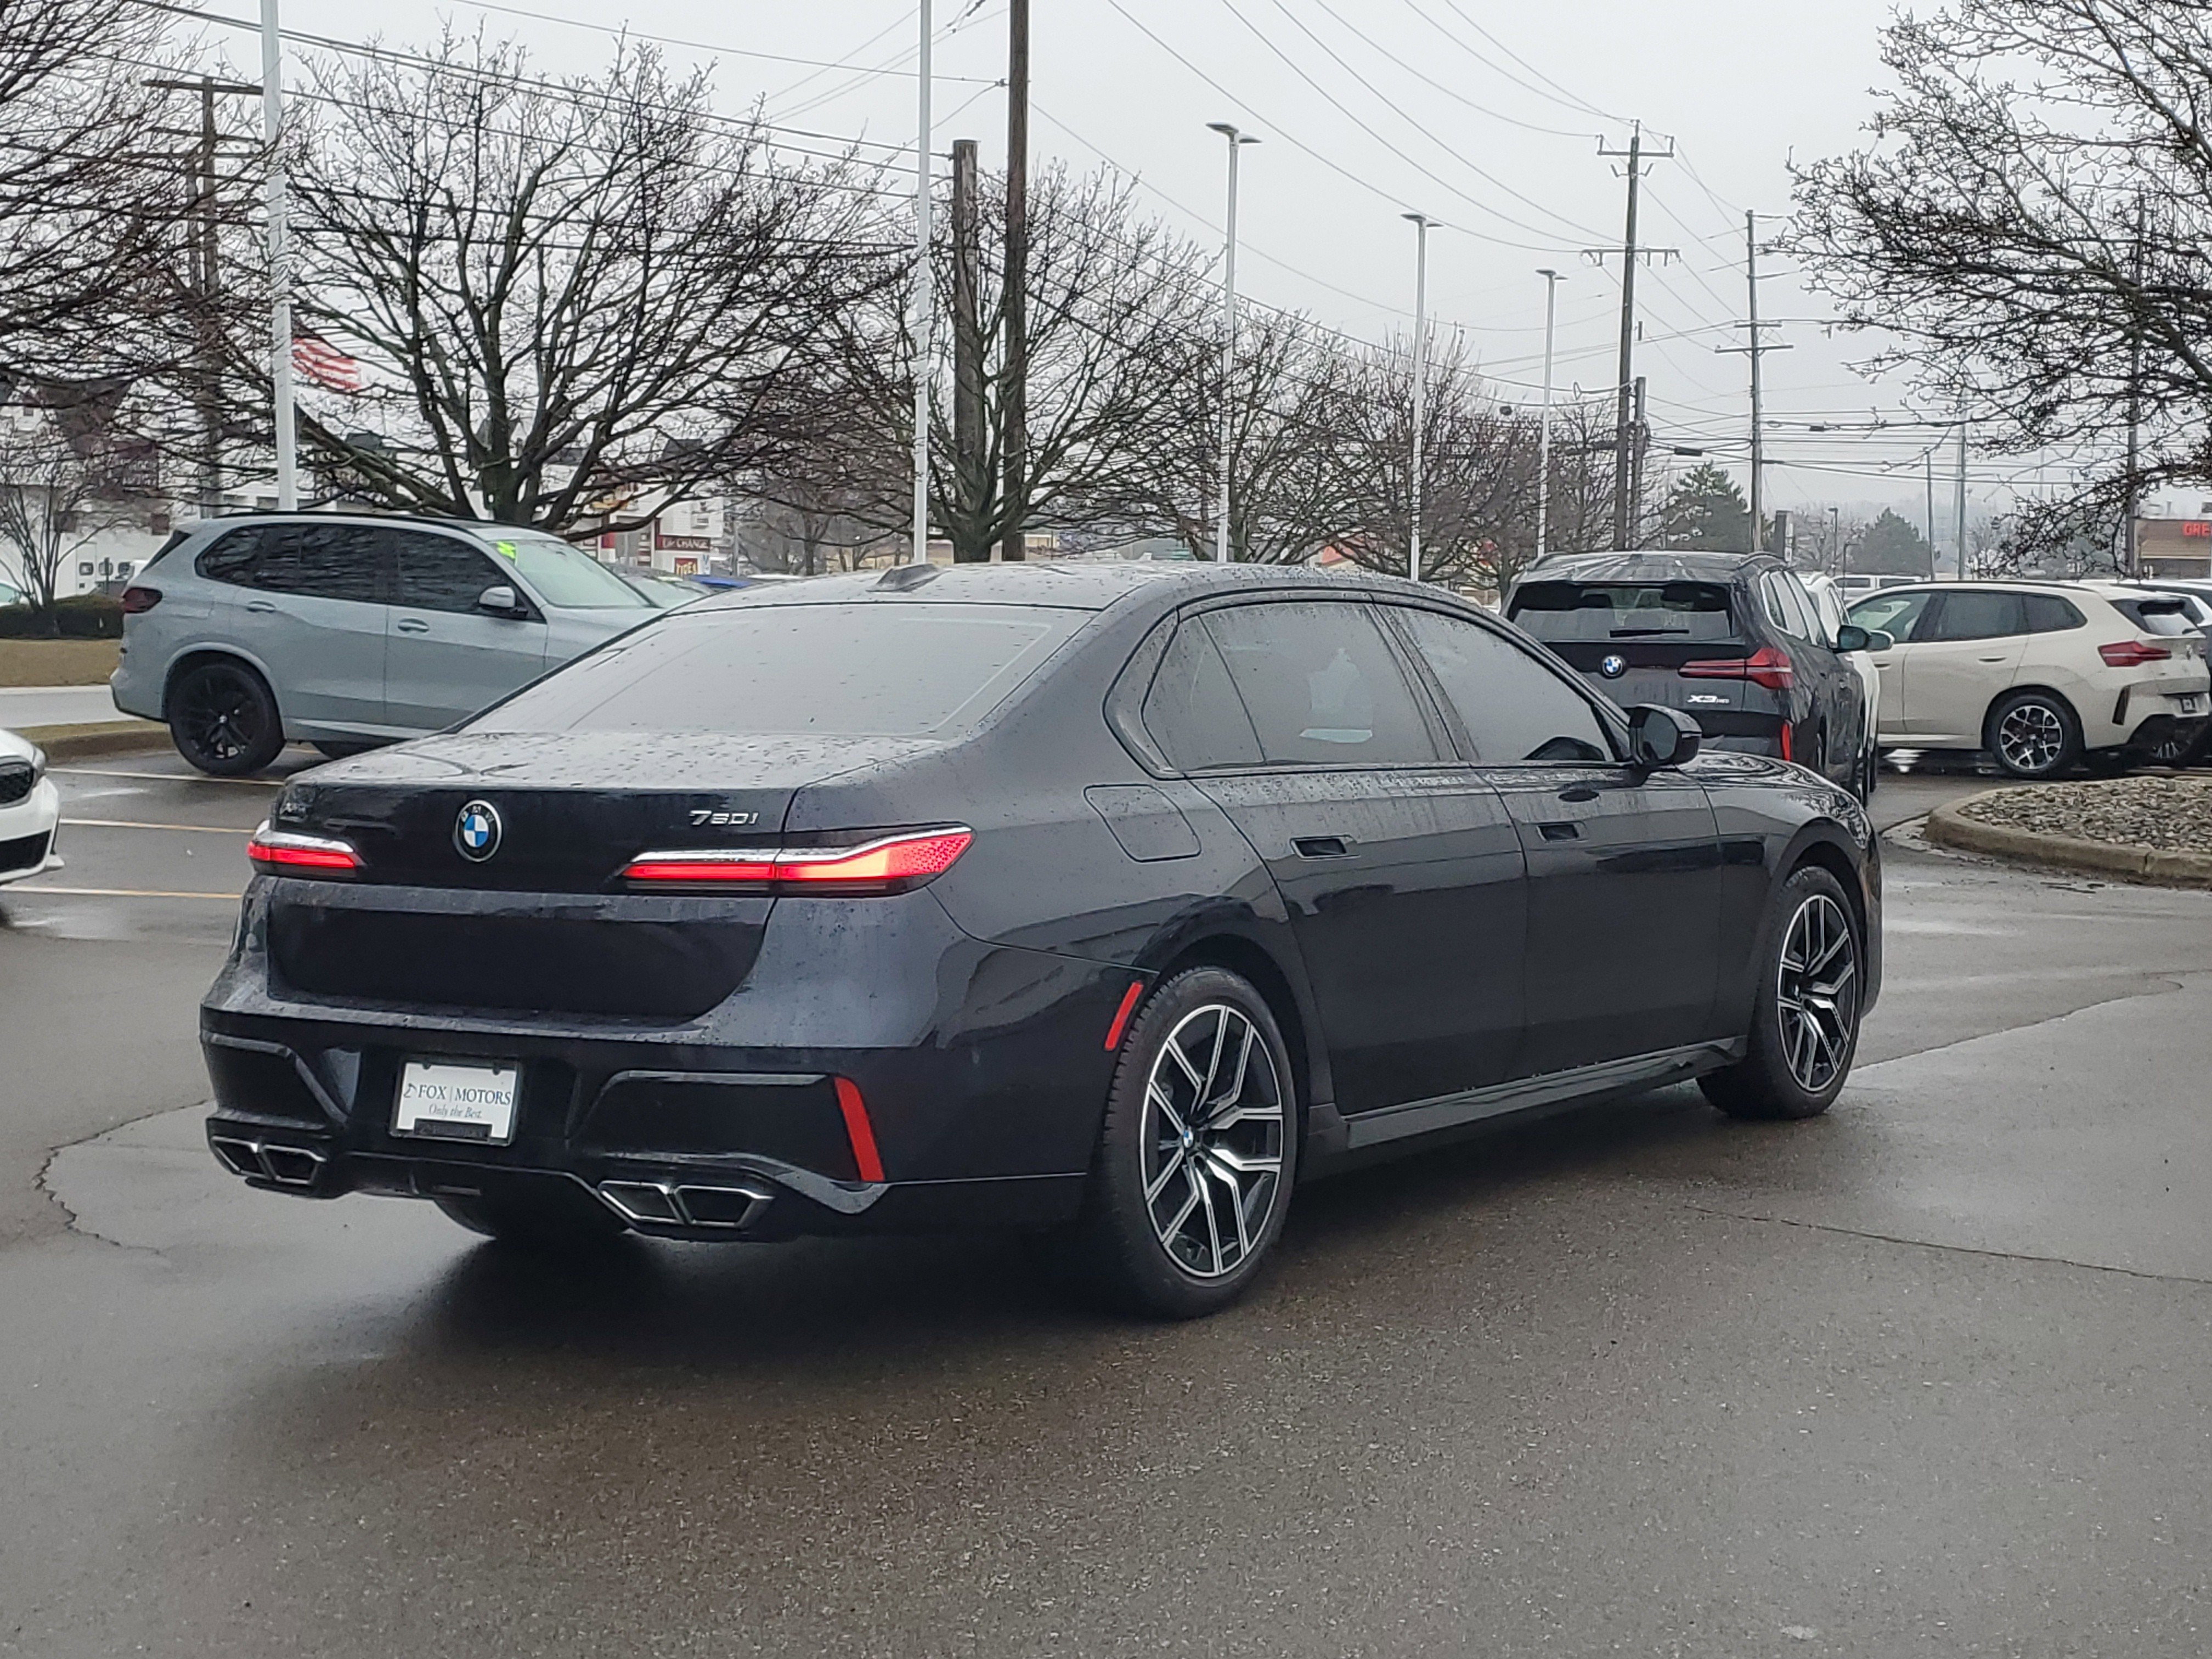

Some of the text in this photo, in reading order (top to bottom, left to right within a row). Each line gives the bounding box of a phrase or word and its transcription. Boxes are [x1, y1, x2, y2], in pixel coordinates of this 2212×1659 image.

[418, 1084, 511, 1105] FOX MOTORS
[429, 1103, 448, 1118] Only
[449, 1104, 463, 1117] the
